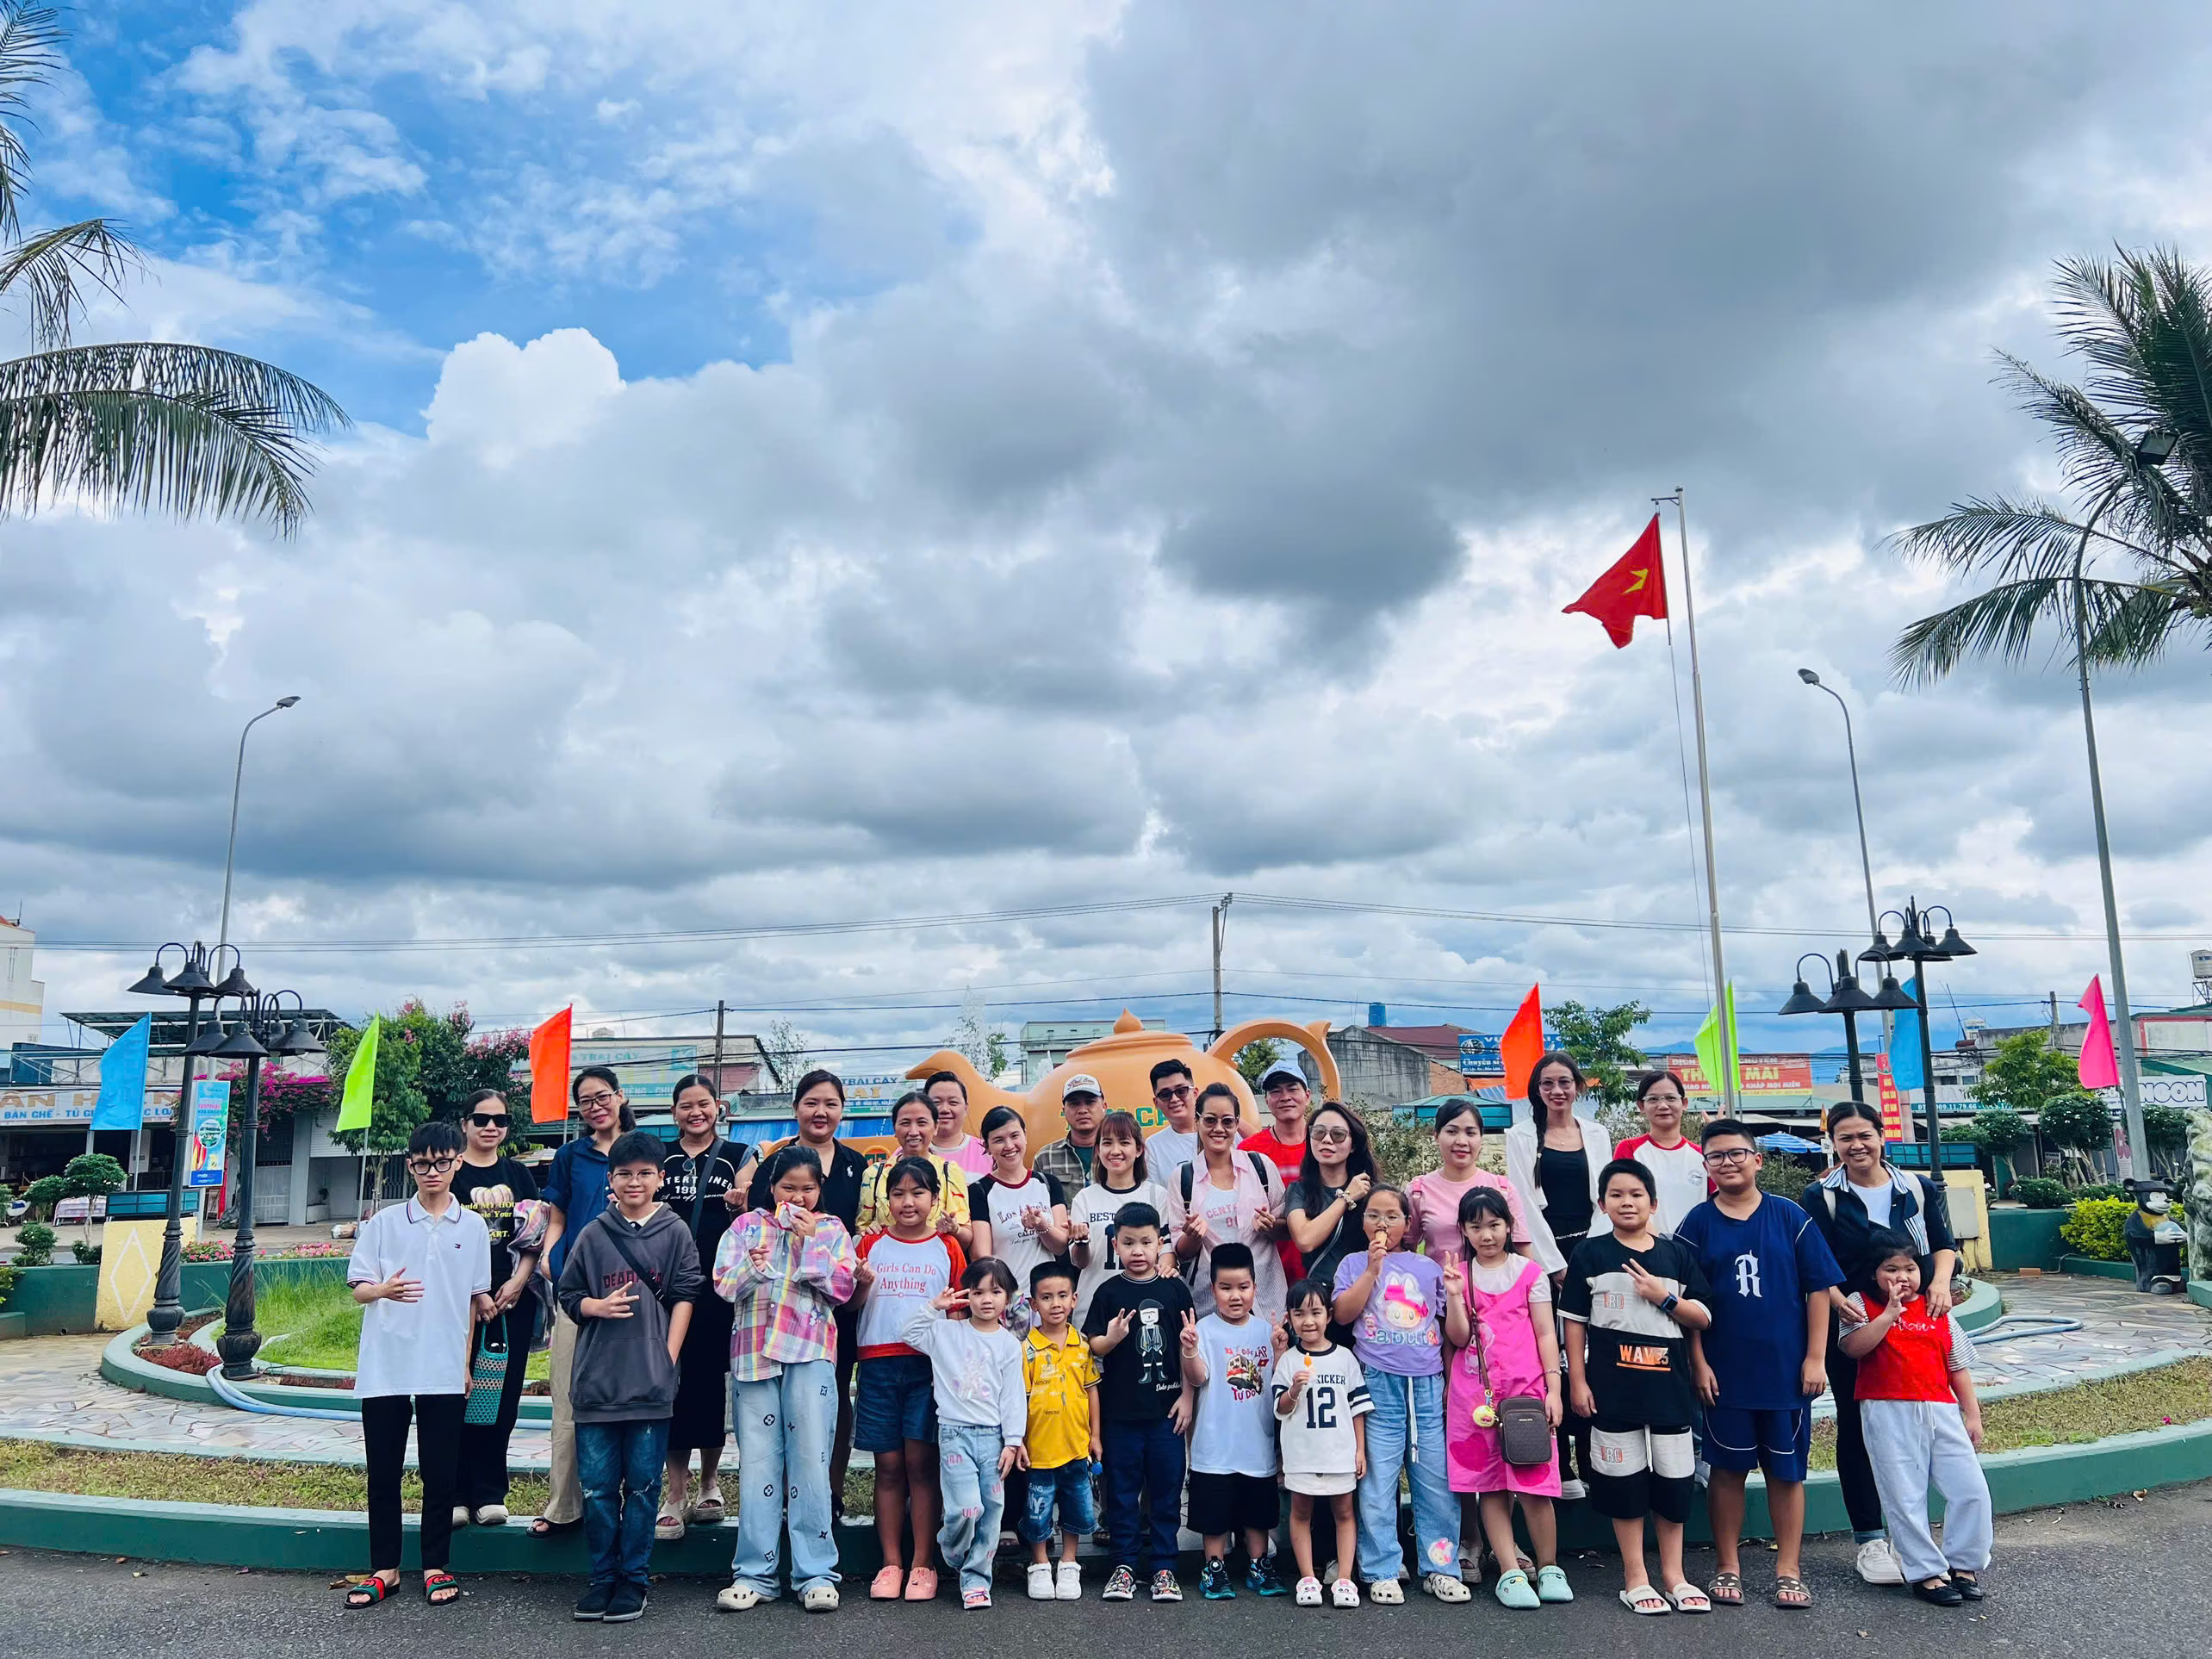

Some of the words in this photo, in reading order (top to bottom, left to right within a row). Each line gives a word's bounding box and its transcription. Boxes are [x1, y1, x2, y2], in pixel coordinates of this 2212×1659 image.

[1745, 1067, 1779, 1080] MAI
[877, 1262, 899, 1274] Girls
[902, 1263, 921, 1273] Can
[924, 1264, 936, 1275] Do
[1734, 1249, 1763, 1298] R
[880, 1277, 927, 1293] Anything
[1306, 1386, 1338, 1429] 12
